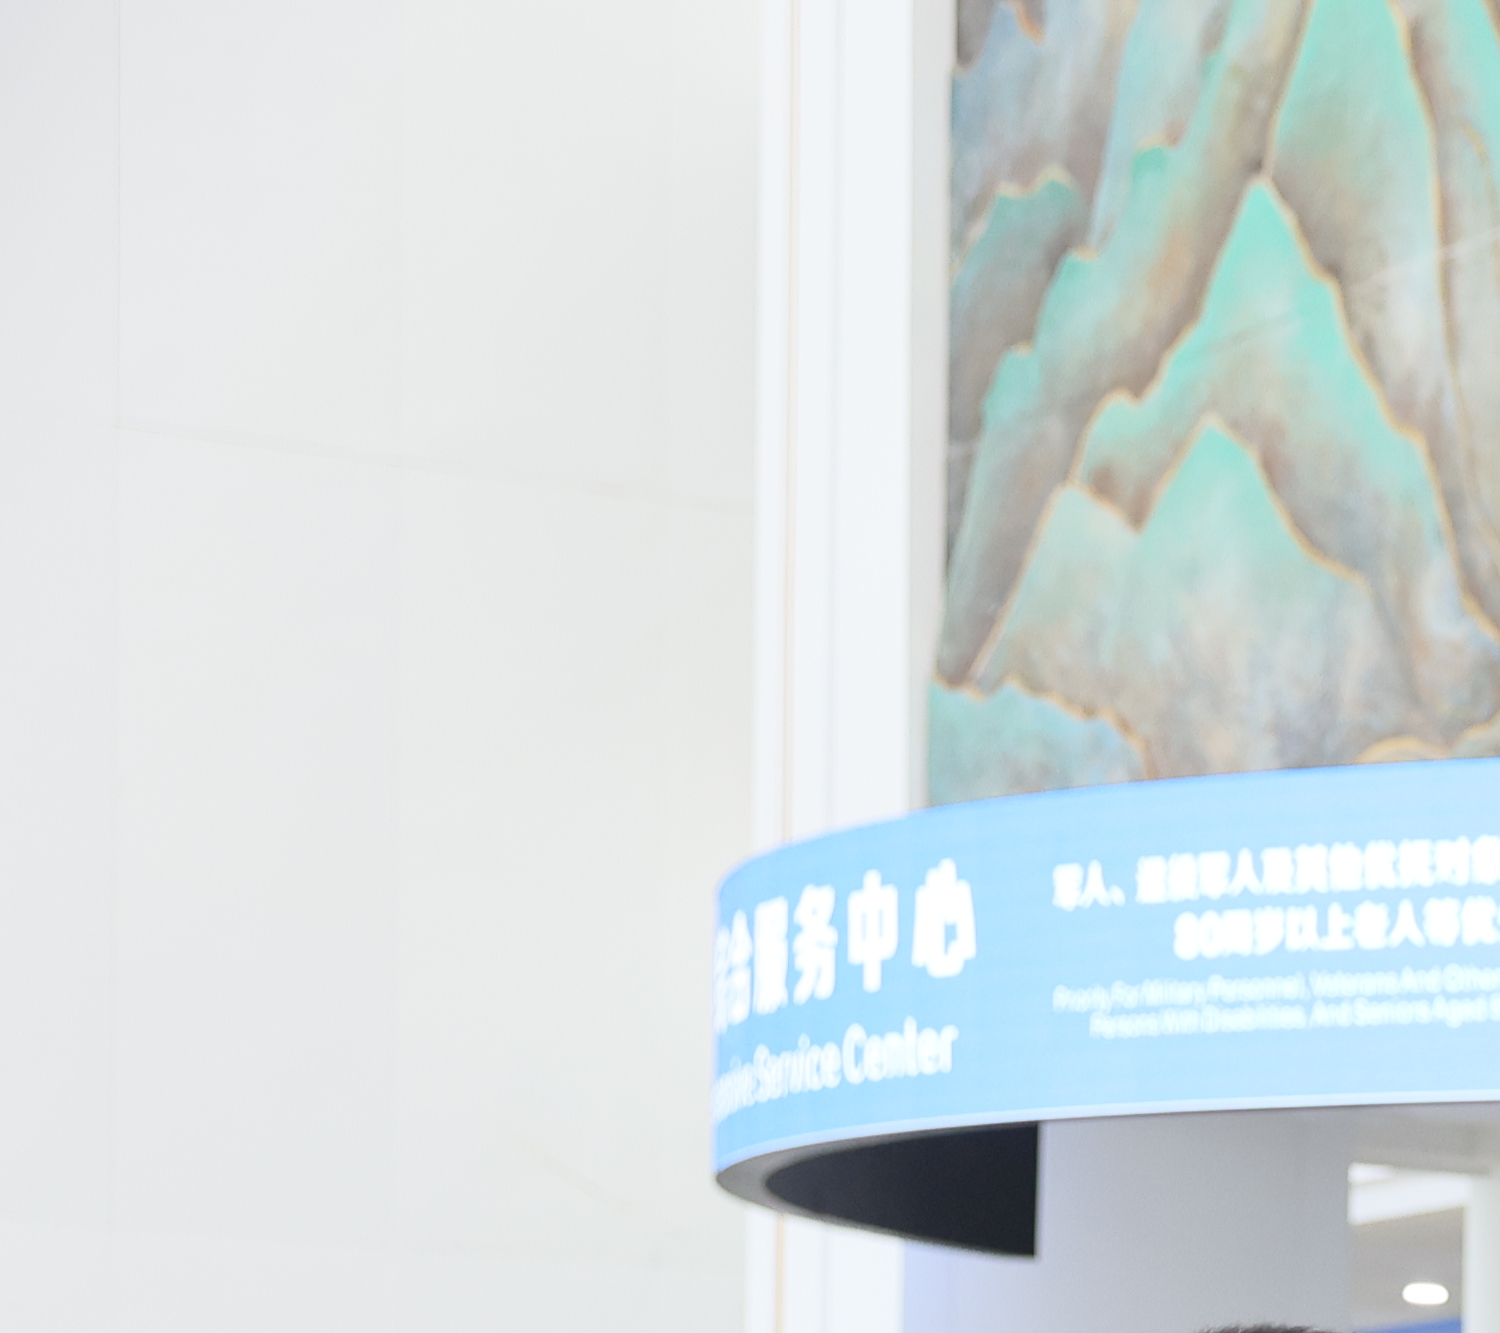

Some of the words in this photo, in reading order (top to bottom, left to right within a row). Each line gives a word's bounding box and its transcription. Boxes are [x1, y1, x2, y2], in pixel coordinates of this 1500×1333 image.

[1400, 965, 1442, 994] And
[753, 1033, 843, 1104] Service
[842, 1015, 959, 1086] Center
